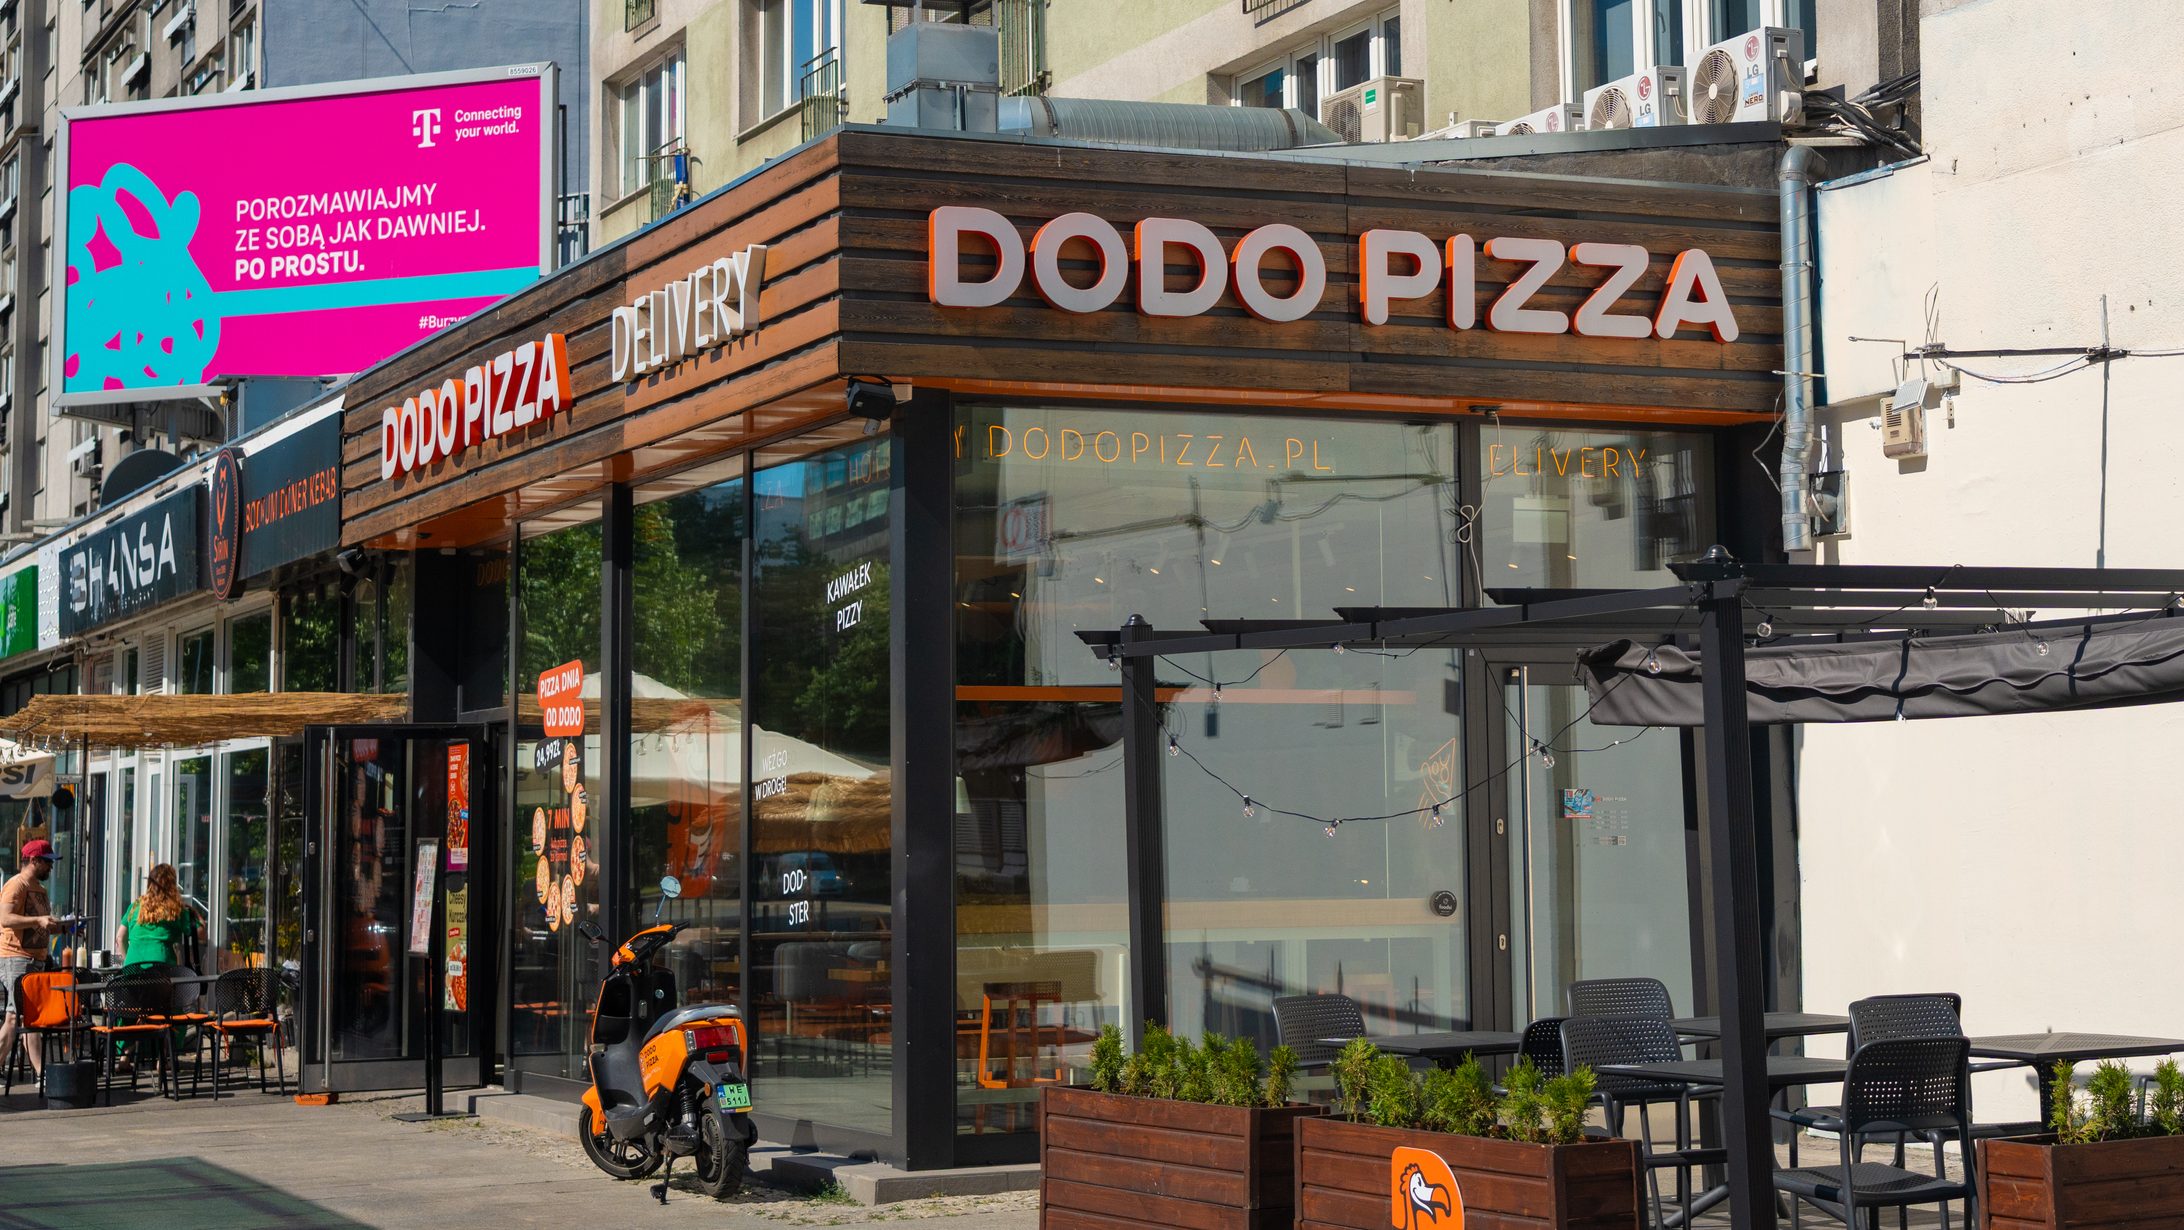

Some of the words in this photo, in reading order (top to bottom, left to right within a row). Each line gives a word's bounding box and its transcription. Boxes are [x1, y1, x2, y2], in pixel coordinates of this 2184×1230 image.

[454, 105, 522, 123] Connecting
[1639, 103, 1652, 117] LG
[455, 126, 481, 141] your
[482, 120, 520, 136] world.
[236, 183, 437, 222] POROZMAWIAJMY
[235, 229, 260, 252] ZE
[266, 223, 326, 249] SOBĄ
[329, 218, 372, 244] JAK
[377, 209, 486, 240] DAWNIEJ.
[235, 257, 265, 281] PO
[270, 249, 365, 278] PROSTU.
[927, 205, 1327, 324] DODO
[1358, 228, 1741, 345] PIZZA
[612, 243, 767, 383] DELIVERY
[381, 378, 465, 480] DODO
[463, 332, 572, 447] PIZZA
[309, 466, 337, 506] KEBAB
[827, 561, 871, 604] KAWAŁEK
[836, 599, 863, 632] PIZZY
[540, 675, 560, 699] PIZZA
[562, 667, 581, 692] DNIA
[546, 707, 557, 727] OD
[559, 706, 581, 727] DODO
[763, 747, 776, 772] WEŹ
[777, 750, 788, 768] GO
[0, 764, 36, 785] SI
[755, 783, 763, 801] W
[547, 809, 553, 830] 7
[554, 807, 570, 829] MIN
[783, 869, 808, 895] DOD-
[788, 900, 809, 926] STER
